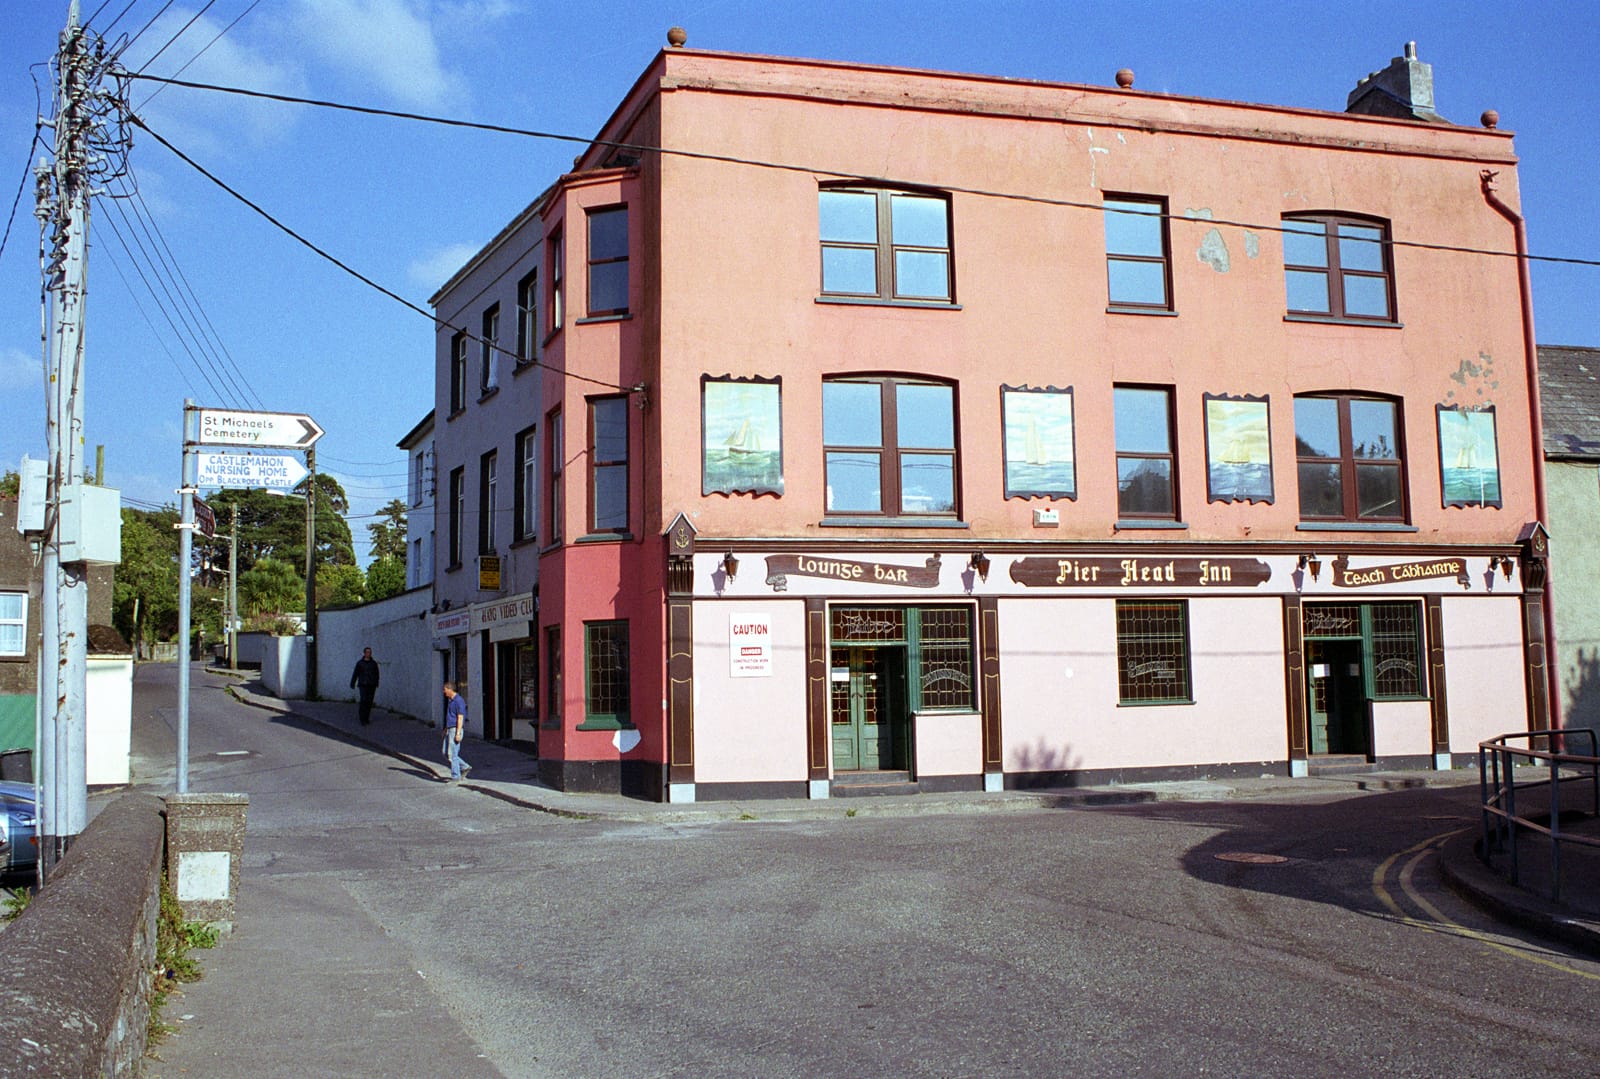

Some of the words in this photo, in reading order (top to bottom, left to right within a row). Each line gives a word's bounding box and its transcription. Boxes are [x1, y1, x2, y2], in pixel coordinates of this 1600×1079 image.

[204, 428, 260, 440] Cemetery
[209, 455, 284, 467] CASTLEMAHON
[205, 465, 250, 476] NURSING
[258, 467, 288, 477] HOME
[264, 477, 292, 486] CASTLE
[1055, 560, 1100, 585] Pier
[1120, 560, 1176, 586] Head
[1199, 560, 1232, 585] Inn
[1343, 569, 1385, 585] Teach
[500, 601, 518, 620] VIDEO
[733, 624, 768, 635] CAUTION
